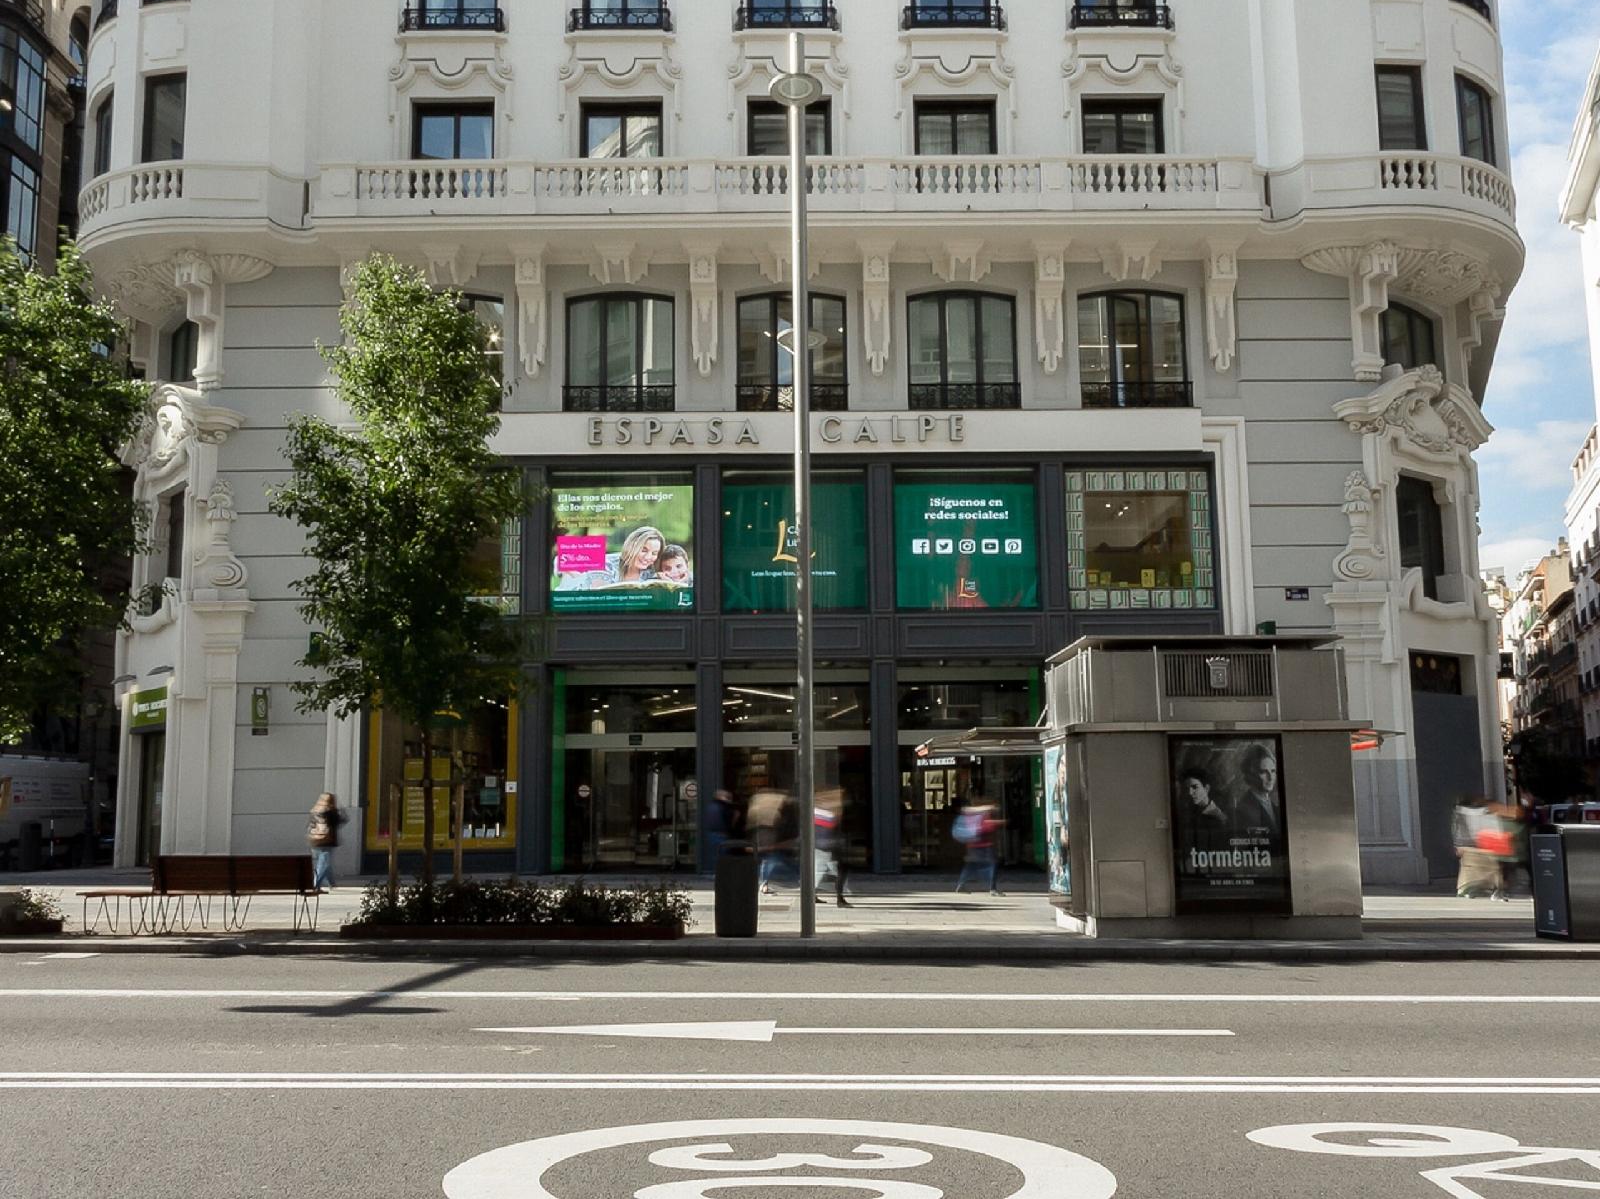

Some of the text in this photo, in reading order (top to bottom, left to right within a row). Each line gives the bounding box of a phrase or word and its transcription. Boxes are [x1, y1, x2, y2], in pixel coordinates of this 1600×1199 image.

[587, 414, 964, 445] ESPASA CALPE
[558, 491, 674, 503] Ellas nos dieron el mejor
[929, 496, 1004, 509] ¡Síguenos en
[557, 503, 569, 512] de
[570, 503, 584, 511] los
[924, 510, 1009, 520] redes sociales!
[1190, 846, 1272, 868] tormenta
